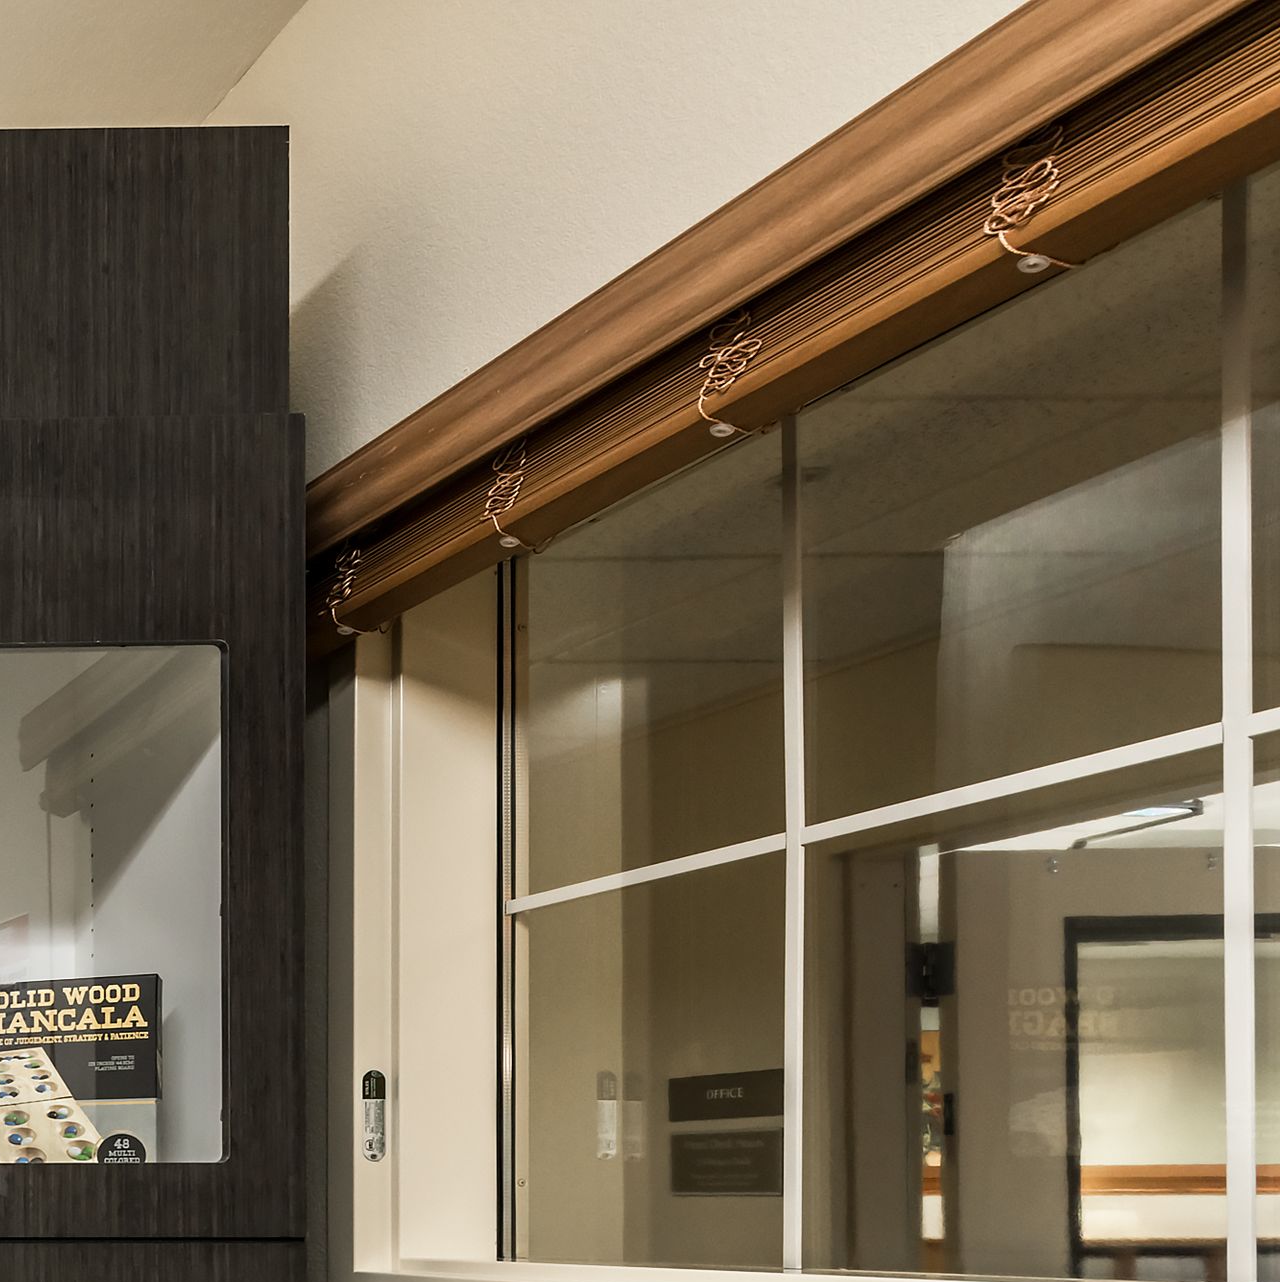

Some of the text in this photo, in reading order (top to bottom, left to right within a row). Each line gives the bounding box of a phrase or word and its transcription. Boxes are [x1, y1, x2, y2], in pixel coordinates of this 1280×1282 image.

[62, 983, 141, 1006] WOOD
[63, 1033, 103, 1043] STRATEGY
[104, 1032, 109, 1041] &
[110, 1031, 149, 1040] PATIENCE
[705, 1087, 744, 1100] OFFICE
[113, 1138, 130, 1149] 48
